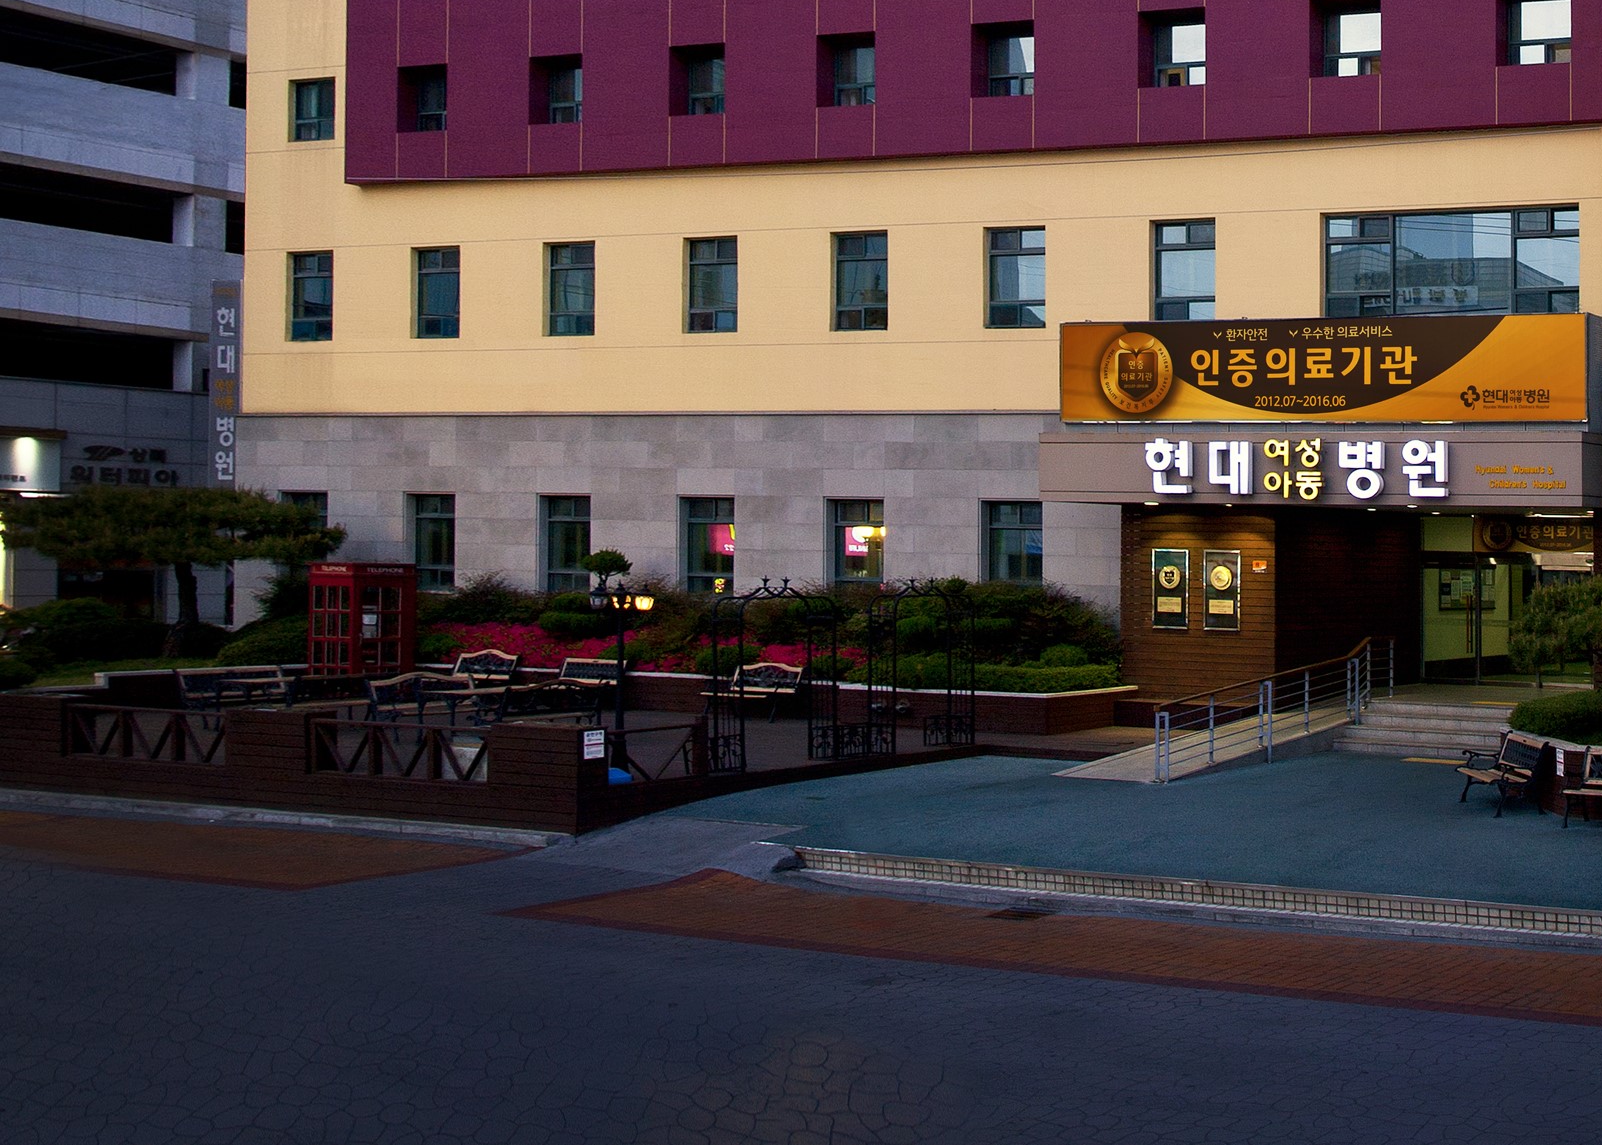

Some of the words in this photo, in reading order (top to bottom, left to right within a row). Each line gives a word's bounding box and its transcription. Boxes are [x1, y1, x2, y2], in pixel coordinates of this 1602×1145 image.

[215, 307, 235, 373] 현대
[1225, 326, 1268, 341] 환자안전
[1301, 326, 1334, 341] 우수한
[1336, 324, 1393, 339] 의료서비스
[1120, 372, 1153, 382] 의료기관
[1128, 360, 1144, 370] 인증
[1190, 346, 1419, 388] 인증의료기관
[1254, 394, 1346, 409] 2012.07~2016.06
[1482, 388, 1508, 403] 현대
[1523, 388, 1550, 404] 병원
[215, 416, 235, 481] 병원
[1263, 437, 1323, 469] 여성
[1144, 437, 1255, 497] 현대
[1338, 439, 1450, 500] 병원
[1263, 469, 1324, 501] 아동
[1532, 479, 1567, 490] Hospital
